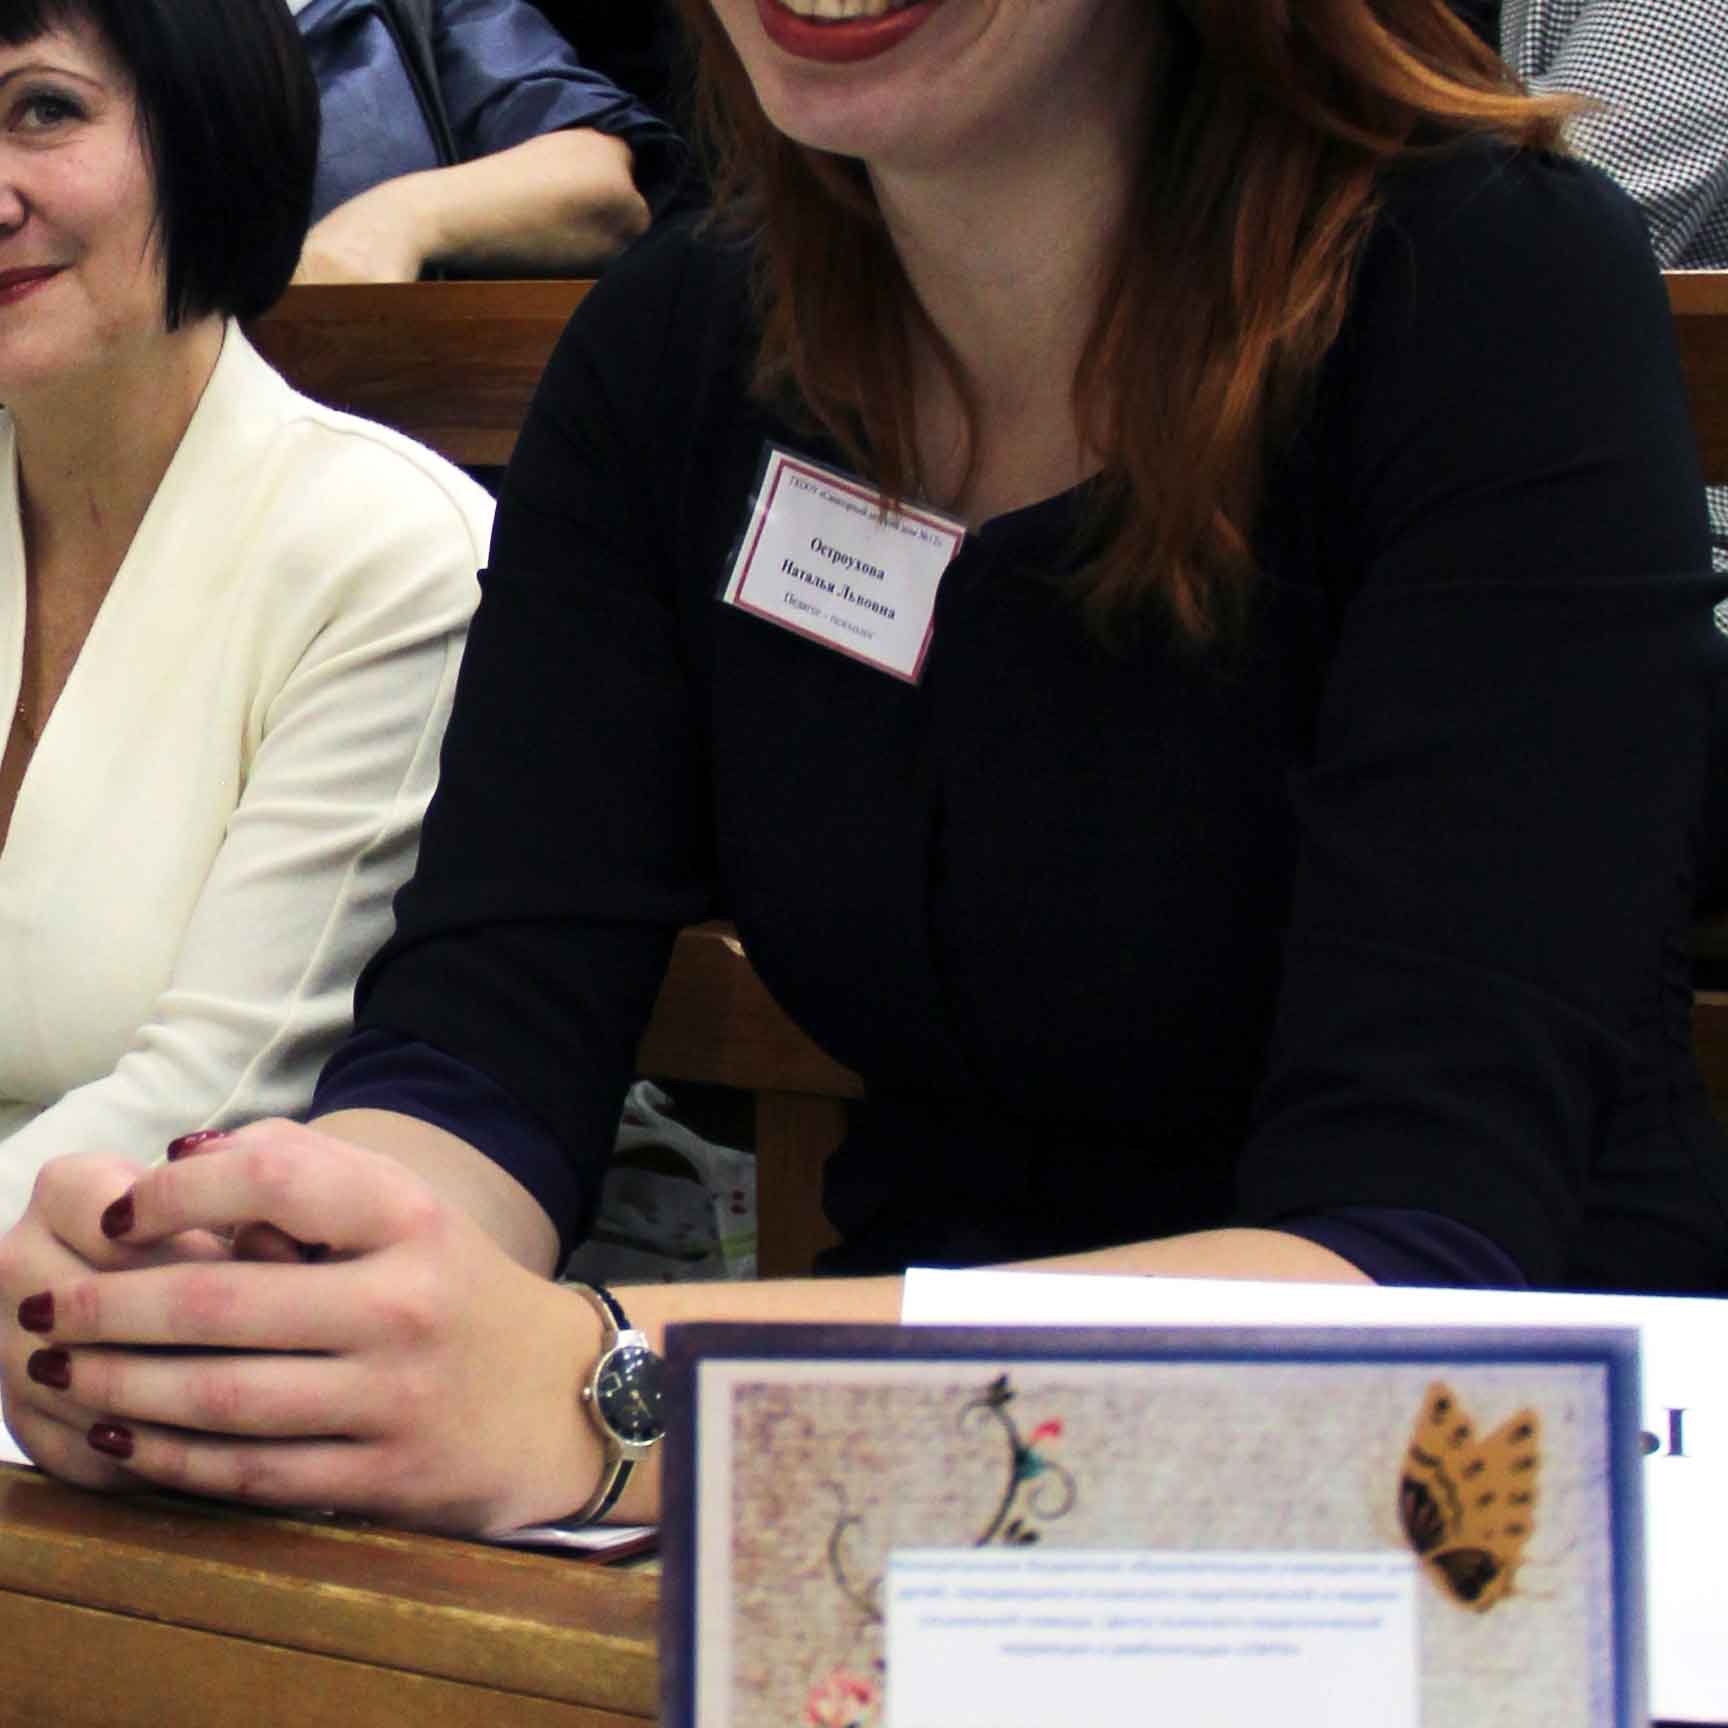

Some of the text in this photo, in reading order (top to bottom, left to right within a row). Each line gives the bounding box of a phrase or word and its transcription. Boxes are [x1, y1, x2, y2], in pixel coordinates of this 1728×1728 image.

[810, 537, 885, 581] Остроухова
[781, 558, 897, 620] Наталья Львовна
